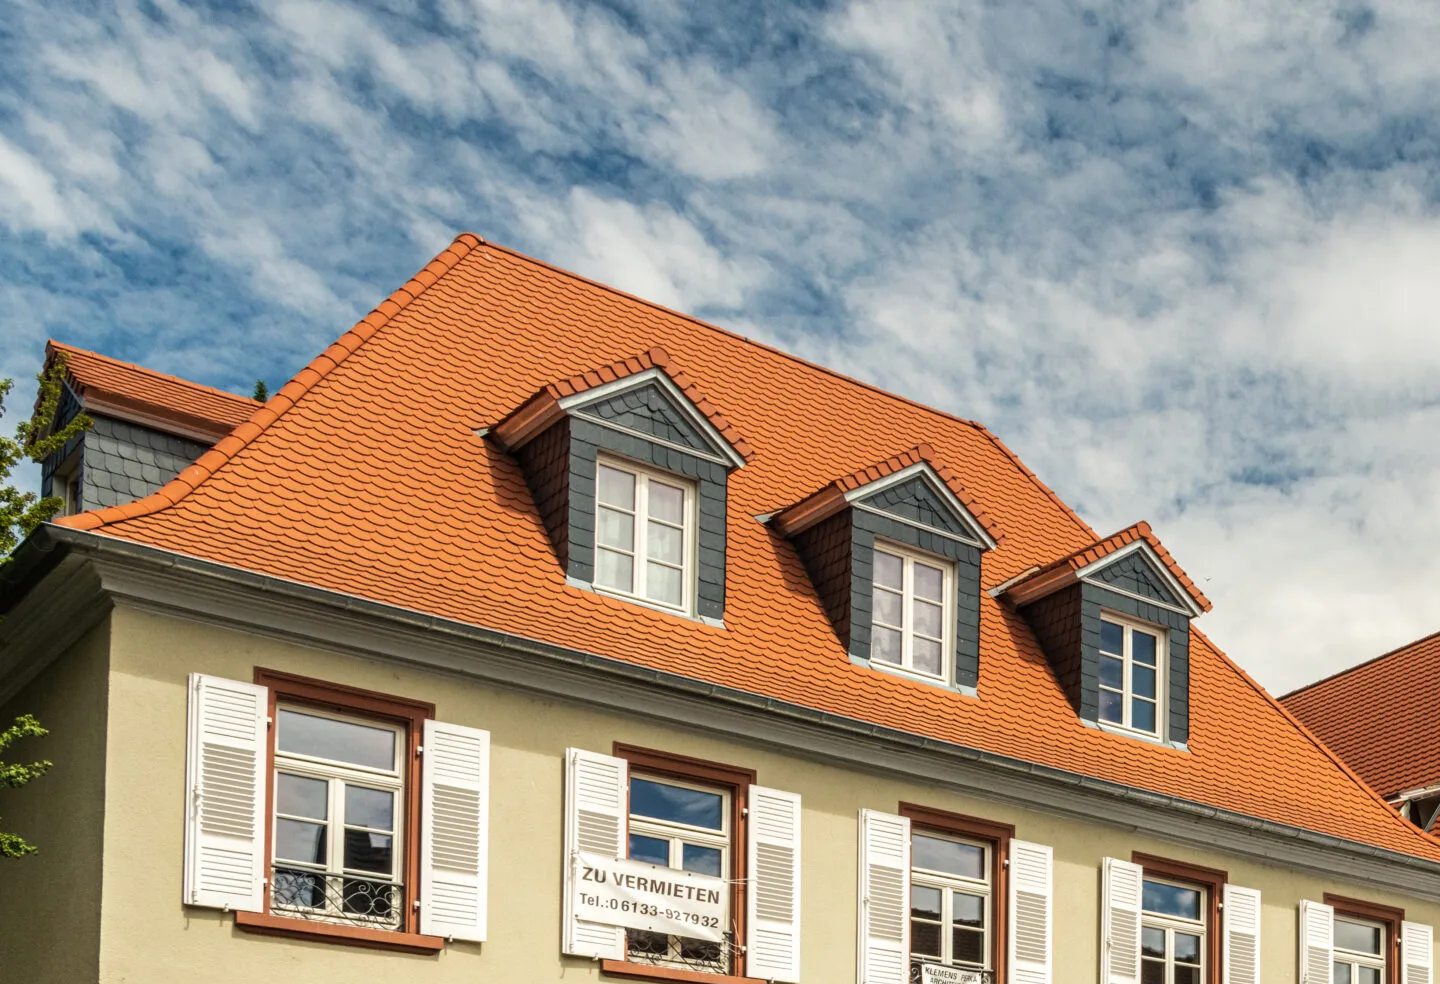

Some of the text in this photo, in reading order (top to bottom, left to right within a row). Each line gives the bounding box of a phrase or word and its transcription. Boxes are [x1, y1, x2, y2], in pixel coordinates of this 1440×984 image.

[582, 866, 720, 904] ZU VERMIETEN
[925, 967, 957, 980] KLEMENS
